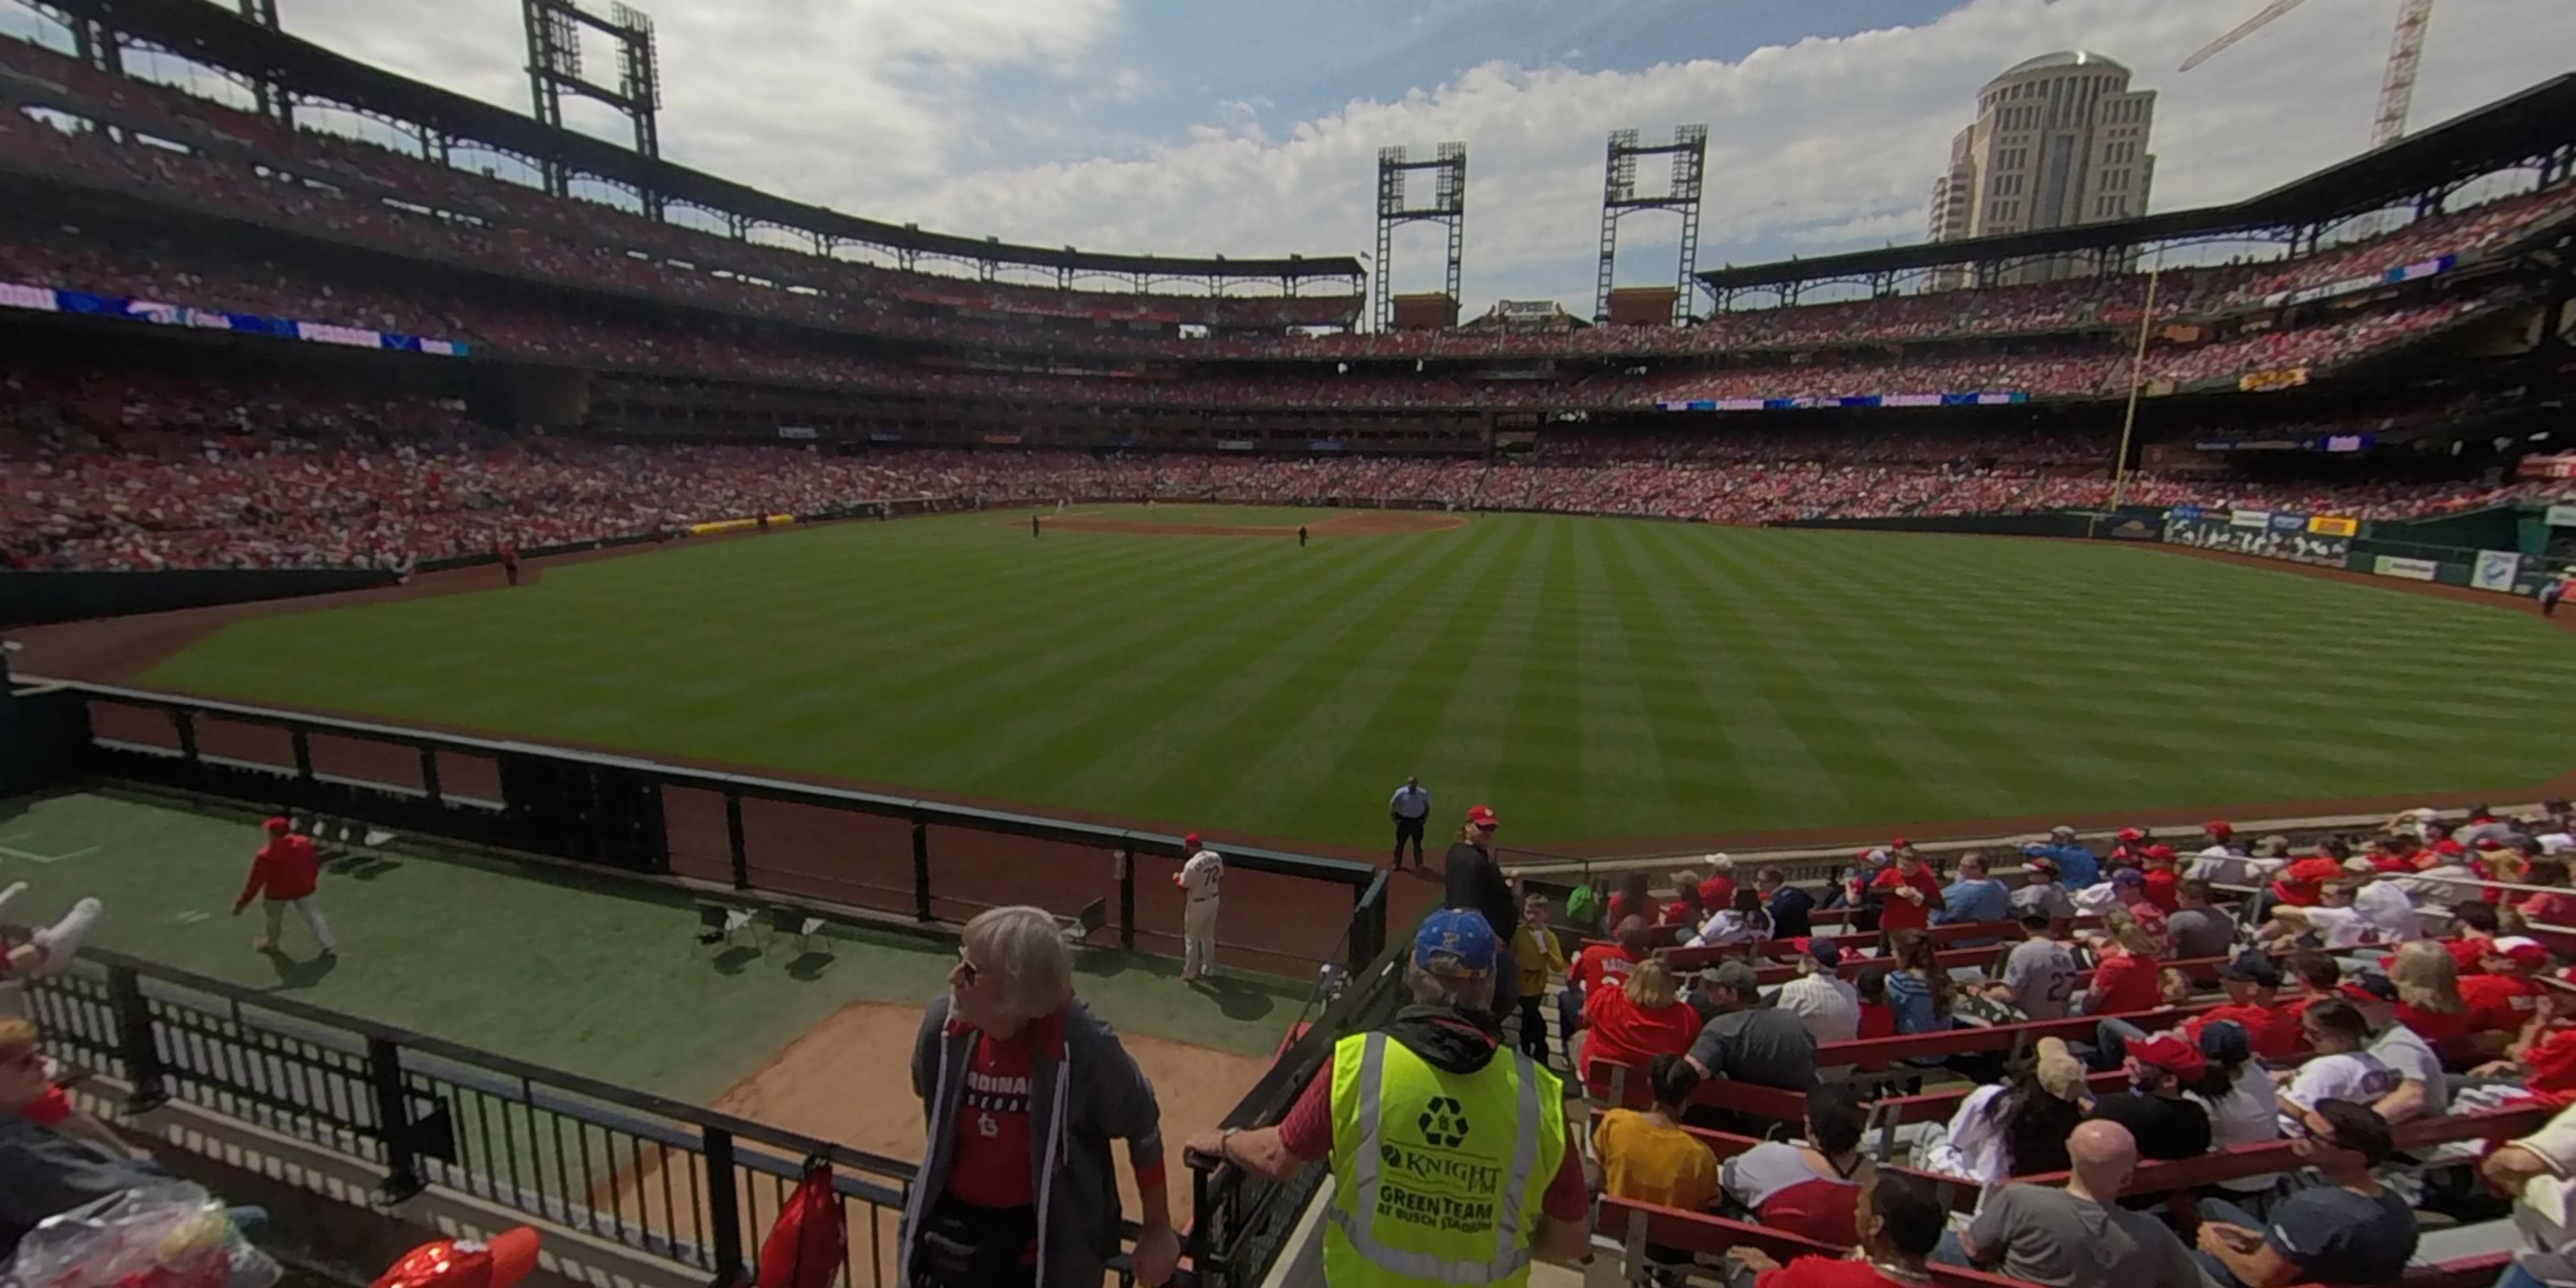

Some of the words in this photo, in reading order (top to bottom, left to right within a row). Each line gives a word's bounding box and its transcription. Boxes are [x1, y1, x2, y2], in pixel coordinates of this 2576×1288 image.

[1203, 864, 1219, 887] 72
[2047, 971, 2076, 1002] 27
[1406, 1151, 1502, 1183] KNIGHT
[1376, 1202, 1393, 1216] AT
[1395, 1206, 1437, 1228] BUSCH
[1440, 1215, 1493, 1234] STADIUM
[1380, 1184, 1441, 1216] GREEN
[1442, 1196, 1494, 1220] TEAM
